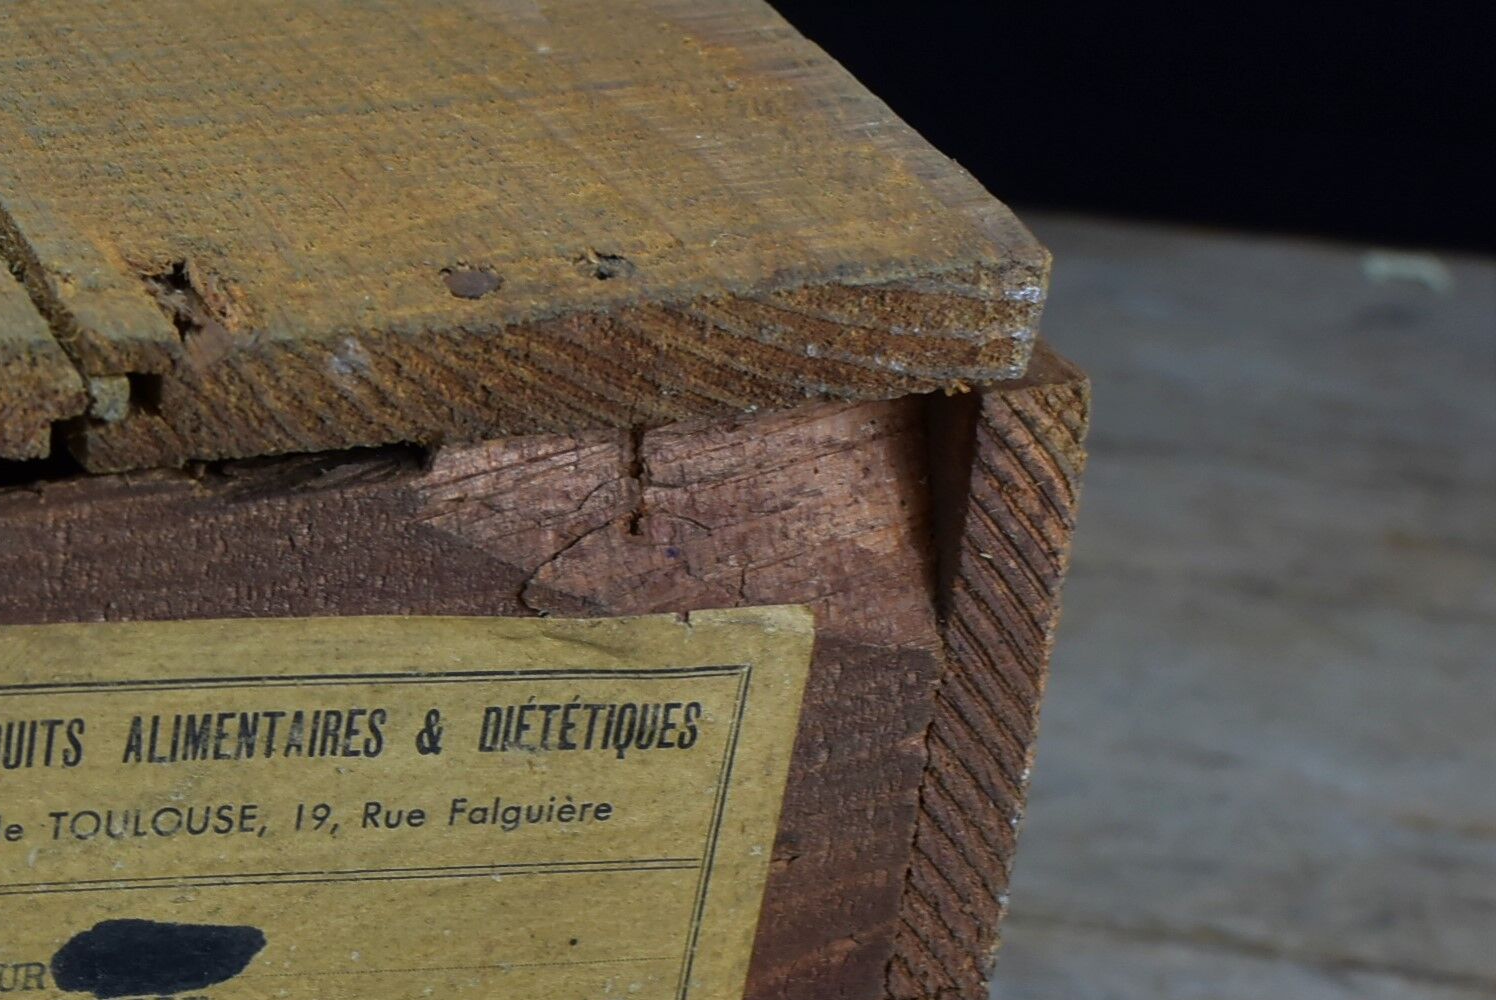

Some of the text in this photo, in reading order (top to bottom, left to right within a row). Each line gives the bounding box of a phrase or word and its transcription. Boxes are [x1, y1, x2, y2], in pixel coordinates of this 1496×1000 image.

[122, 708, 387, 765] ALIMENTAIRES
[414, 709, 443, 756] &
[478, 695, 702, 759] DIÉTÉTIQUES
[48, 804, 269, 841] TOULOUSE,
[295, 803, 340, 836] 19,
[361, 801, 426, 829] Rue
[447, 797, 614, 832] Falguière
